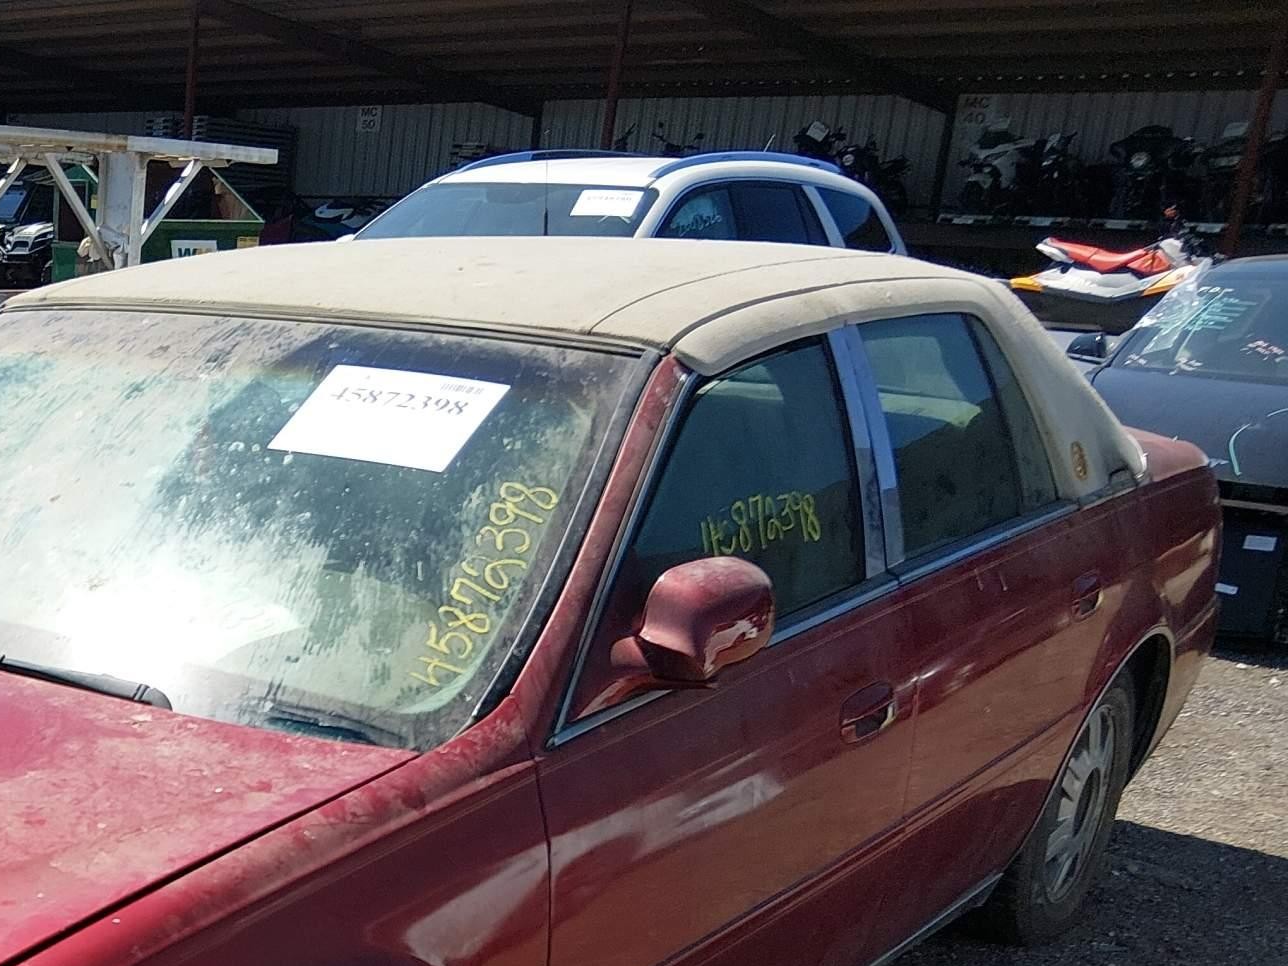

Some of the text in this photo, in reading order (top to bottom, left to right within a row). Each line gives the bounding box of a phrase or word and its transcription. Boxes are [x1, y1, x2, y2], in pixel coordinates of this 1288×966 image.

[361, 107, 378, 117] MC
[361, 119, 376, 130] 50
[330, 386, 469, 416] 45872398
